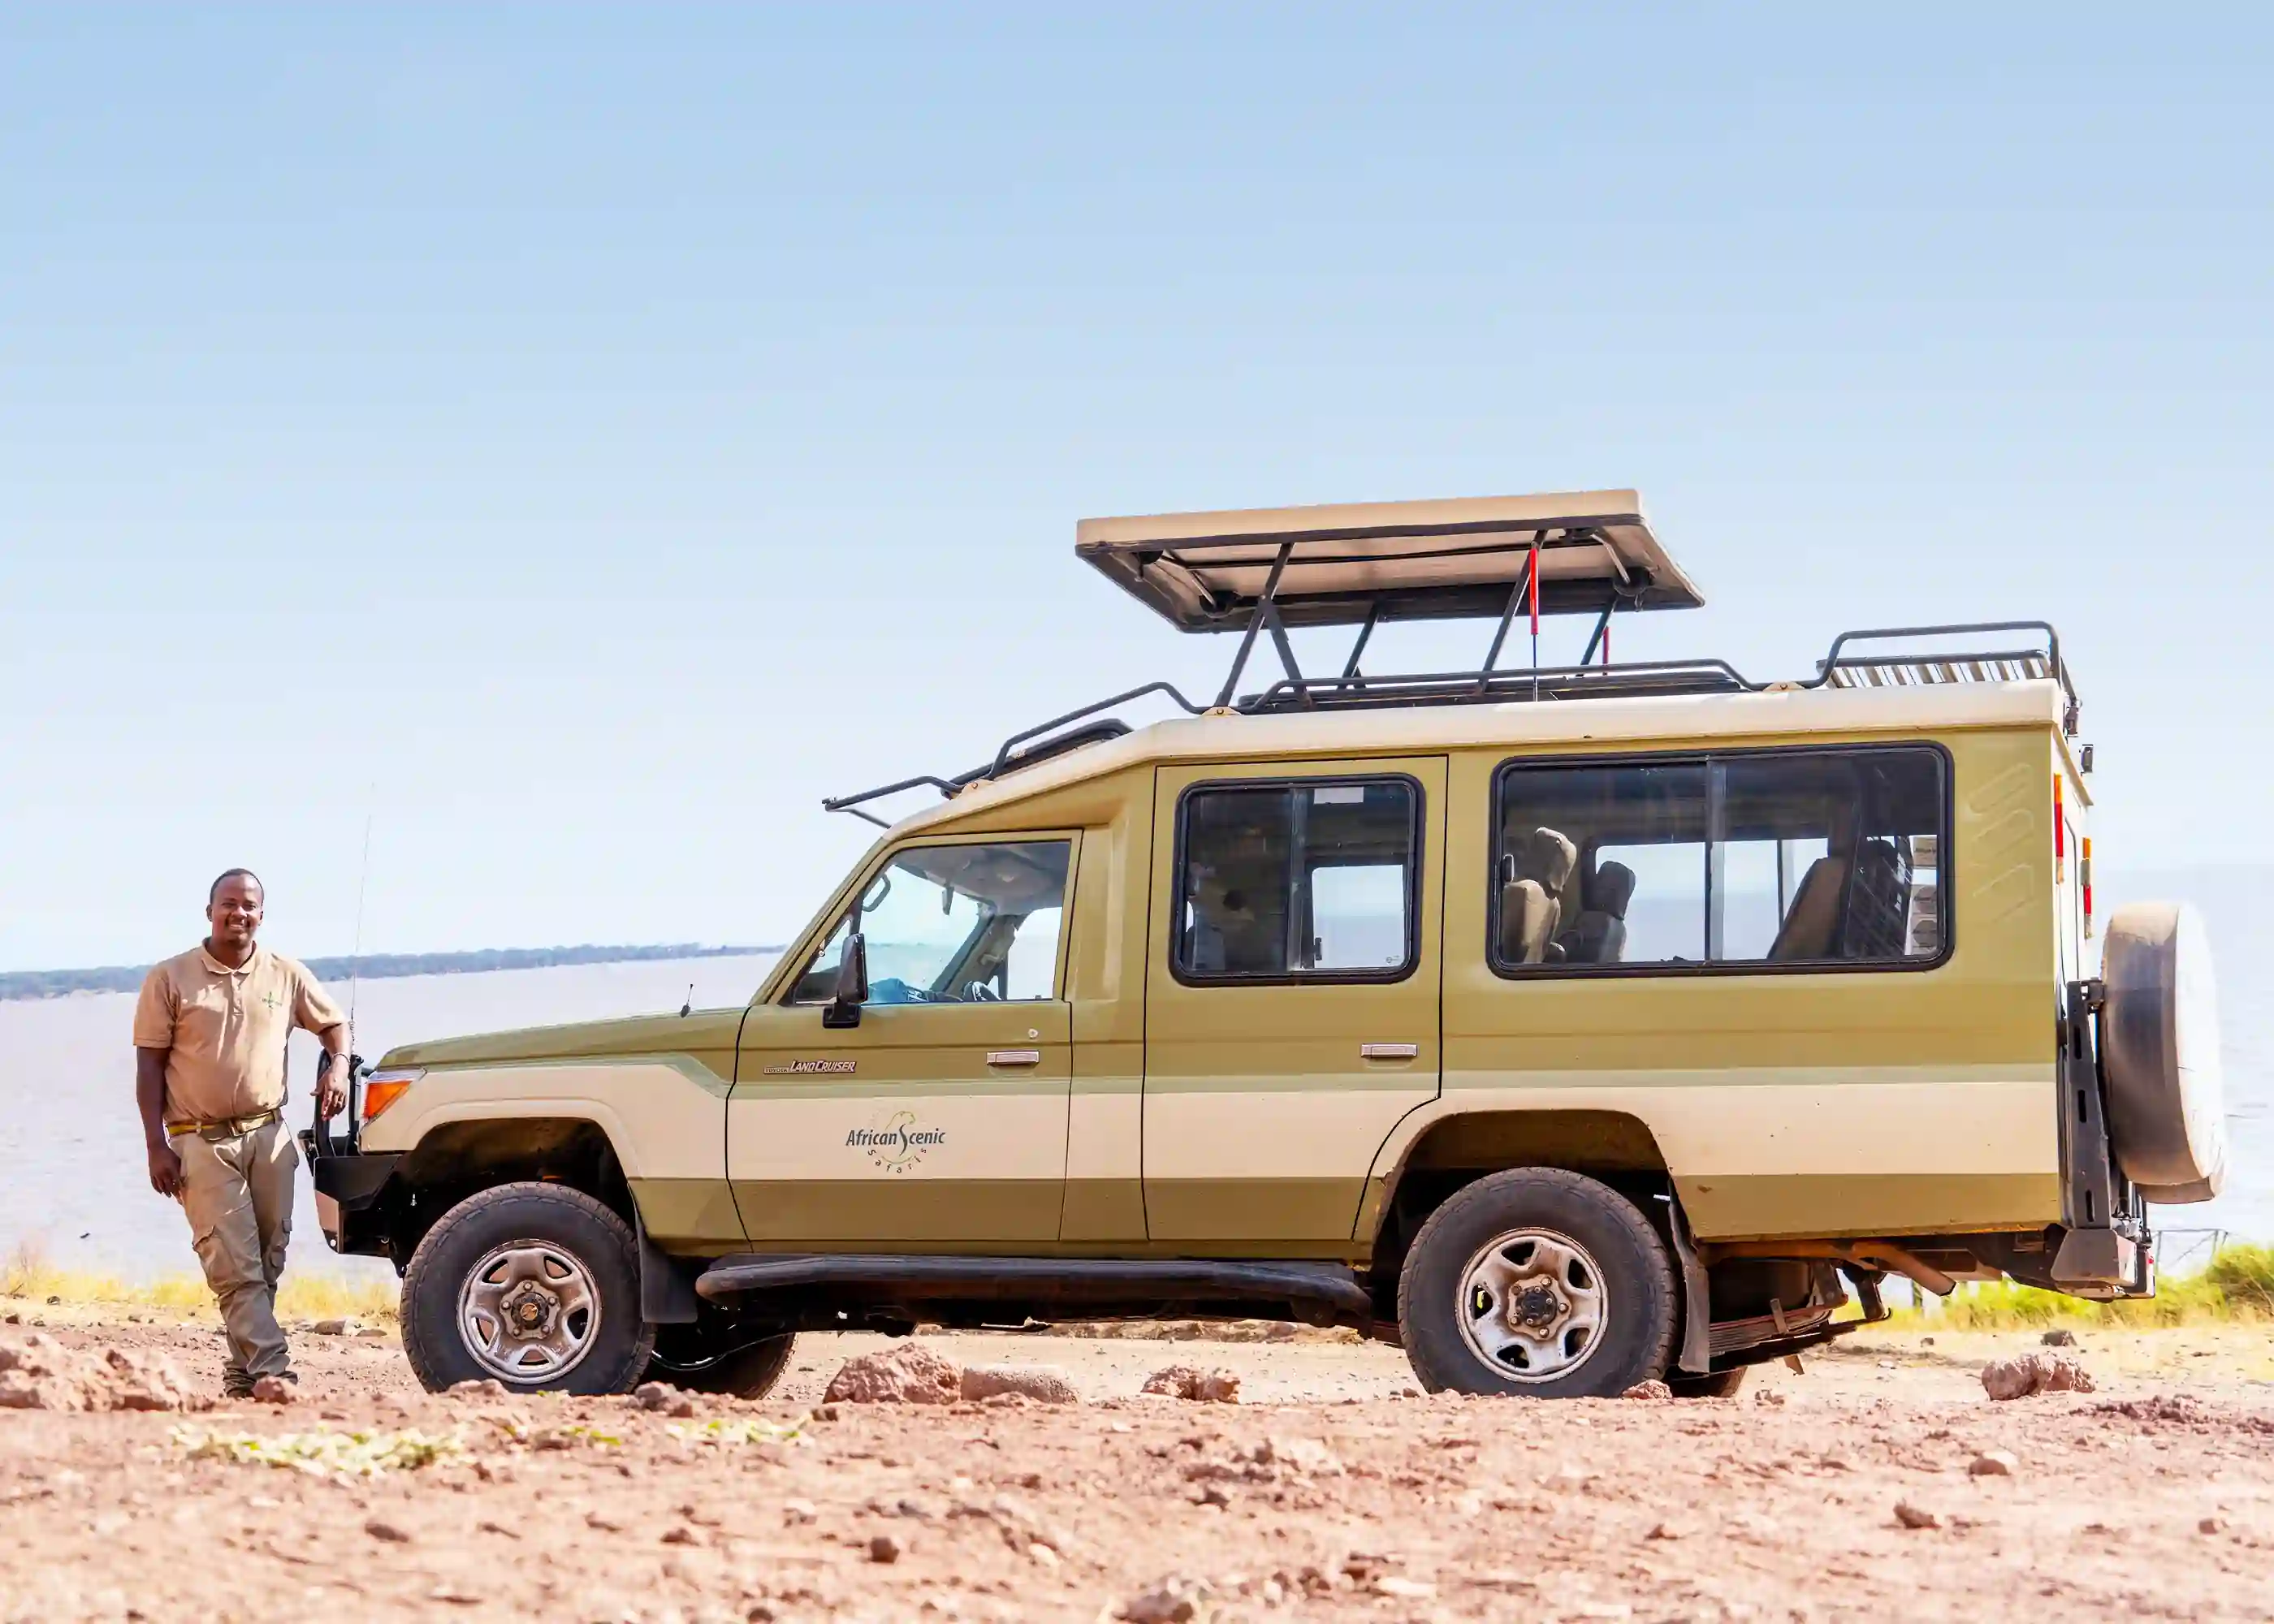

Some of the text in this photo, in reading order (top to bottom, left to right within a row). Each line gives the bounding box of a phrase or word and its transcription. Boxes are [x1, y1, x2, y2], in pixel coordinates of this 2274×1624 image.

[814, 1060, 857, 1073] CRUISER
[845, 1123, 946, 1157] African Scenic
[867, 1147, 927, 1174] Safaris
